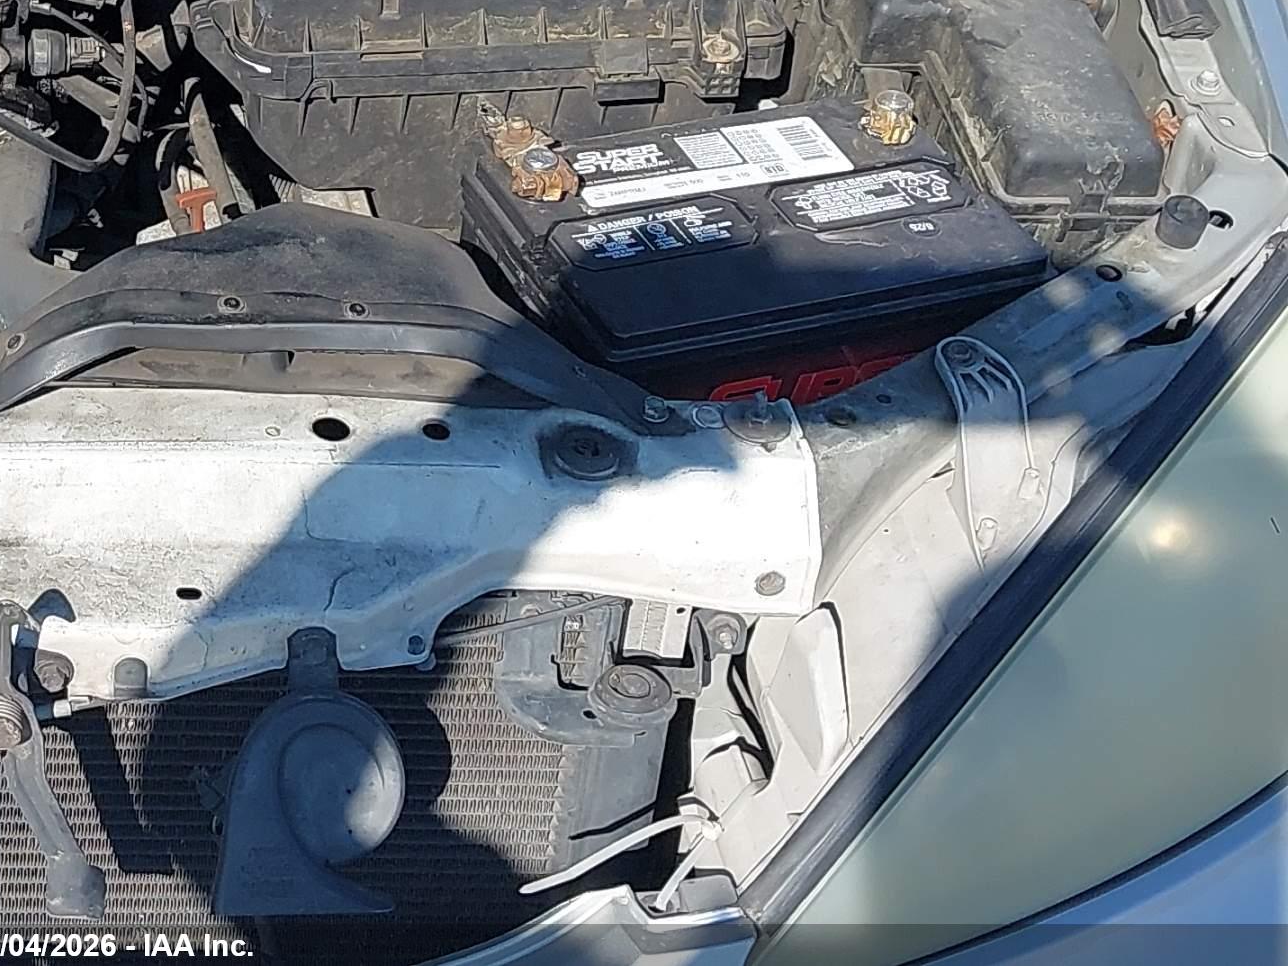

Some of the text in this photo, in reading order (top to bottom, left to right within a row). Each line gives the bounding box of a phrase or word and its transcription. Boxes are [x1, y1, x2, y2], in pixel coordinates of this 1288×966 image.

[573, 152, 664, 175] START
[576, 143, 661, 164] SUPER
[598, 215, 648, 231] DANGER
[655, 205, 701, 220] POISON
